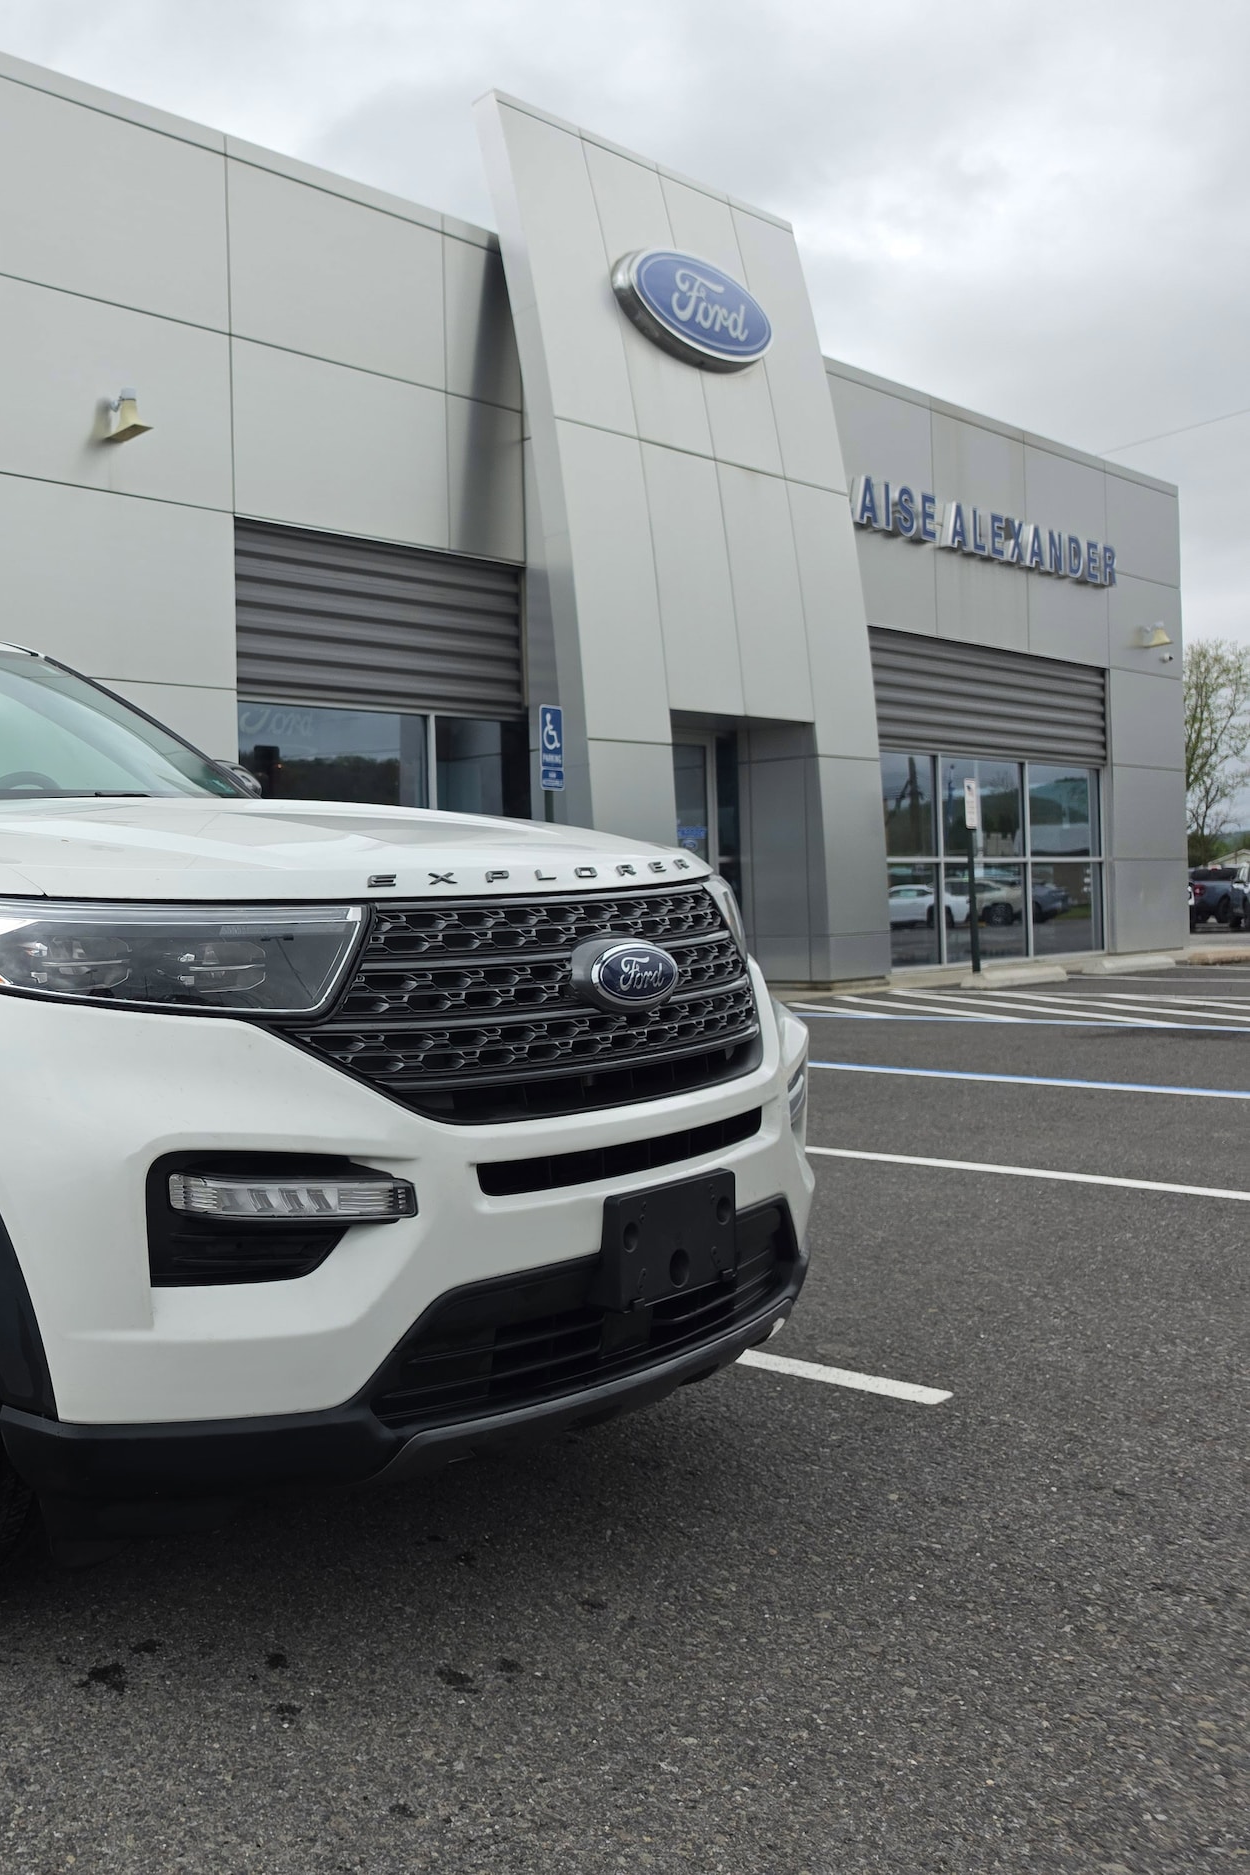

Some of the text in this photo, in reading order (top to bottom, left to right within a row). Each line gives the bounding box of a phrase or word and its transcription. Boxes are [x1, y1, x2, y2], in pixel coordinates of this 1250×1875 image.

[671, 269, 748, 341] Ford
[948, 501, 1117, 586] ALEXANDER
[367, 858, 690, 888] EXPLORER
[619, 956, 664, 991] Ford
